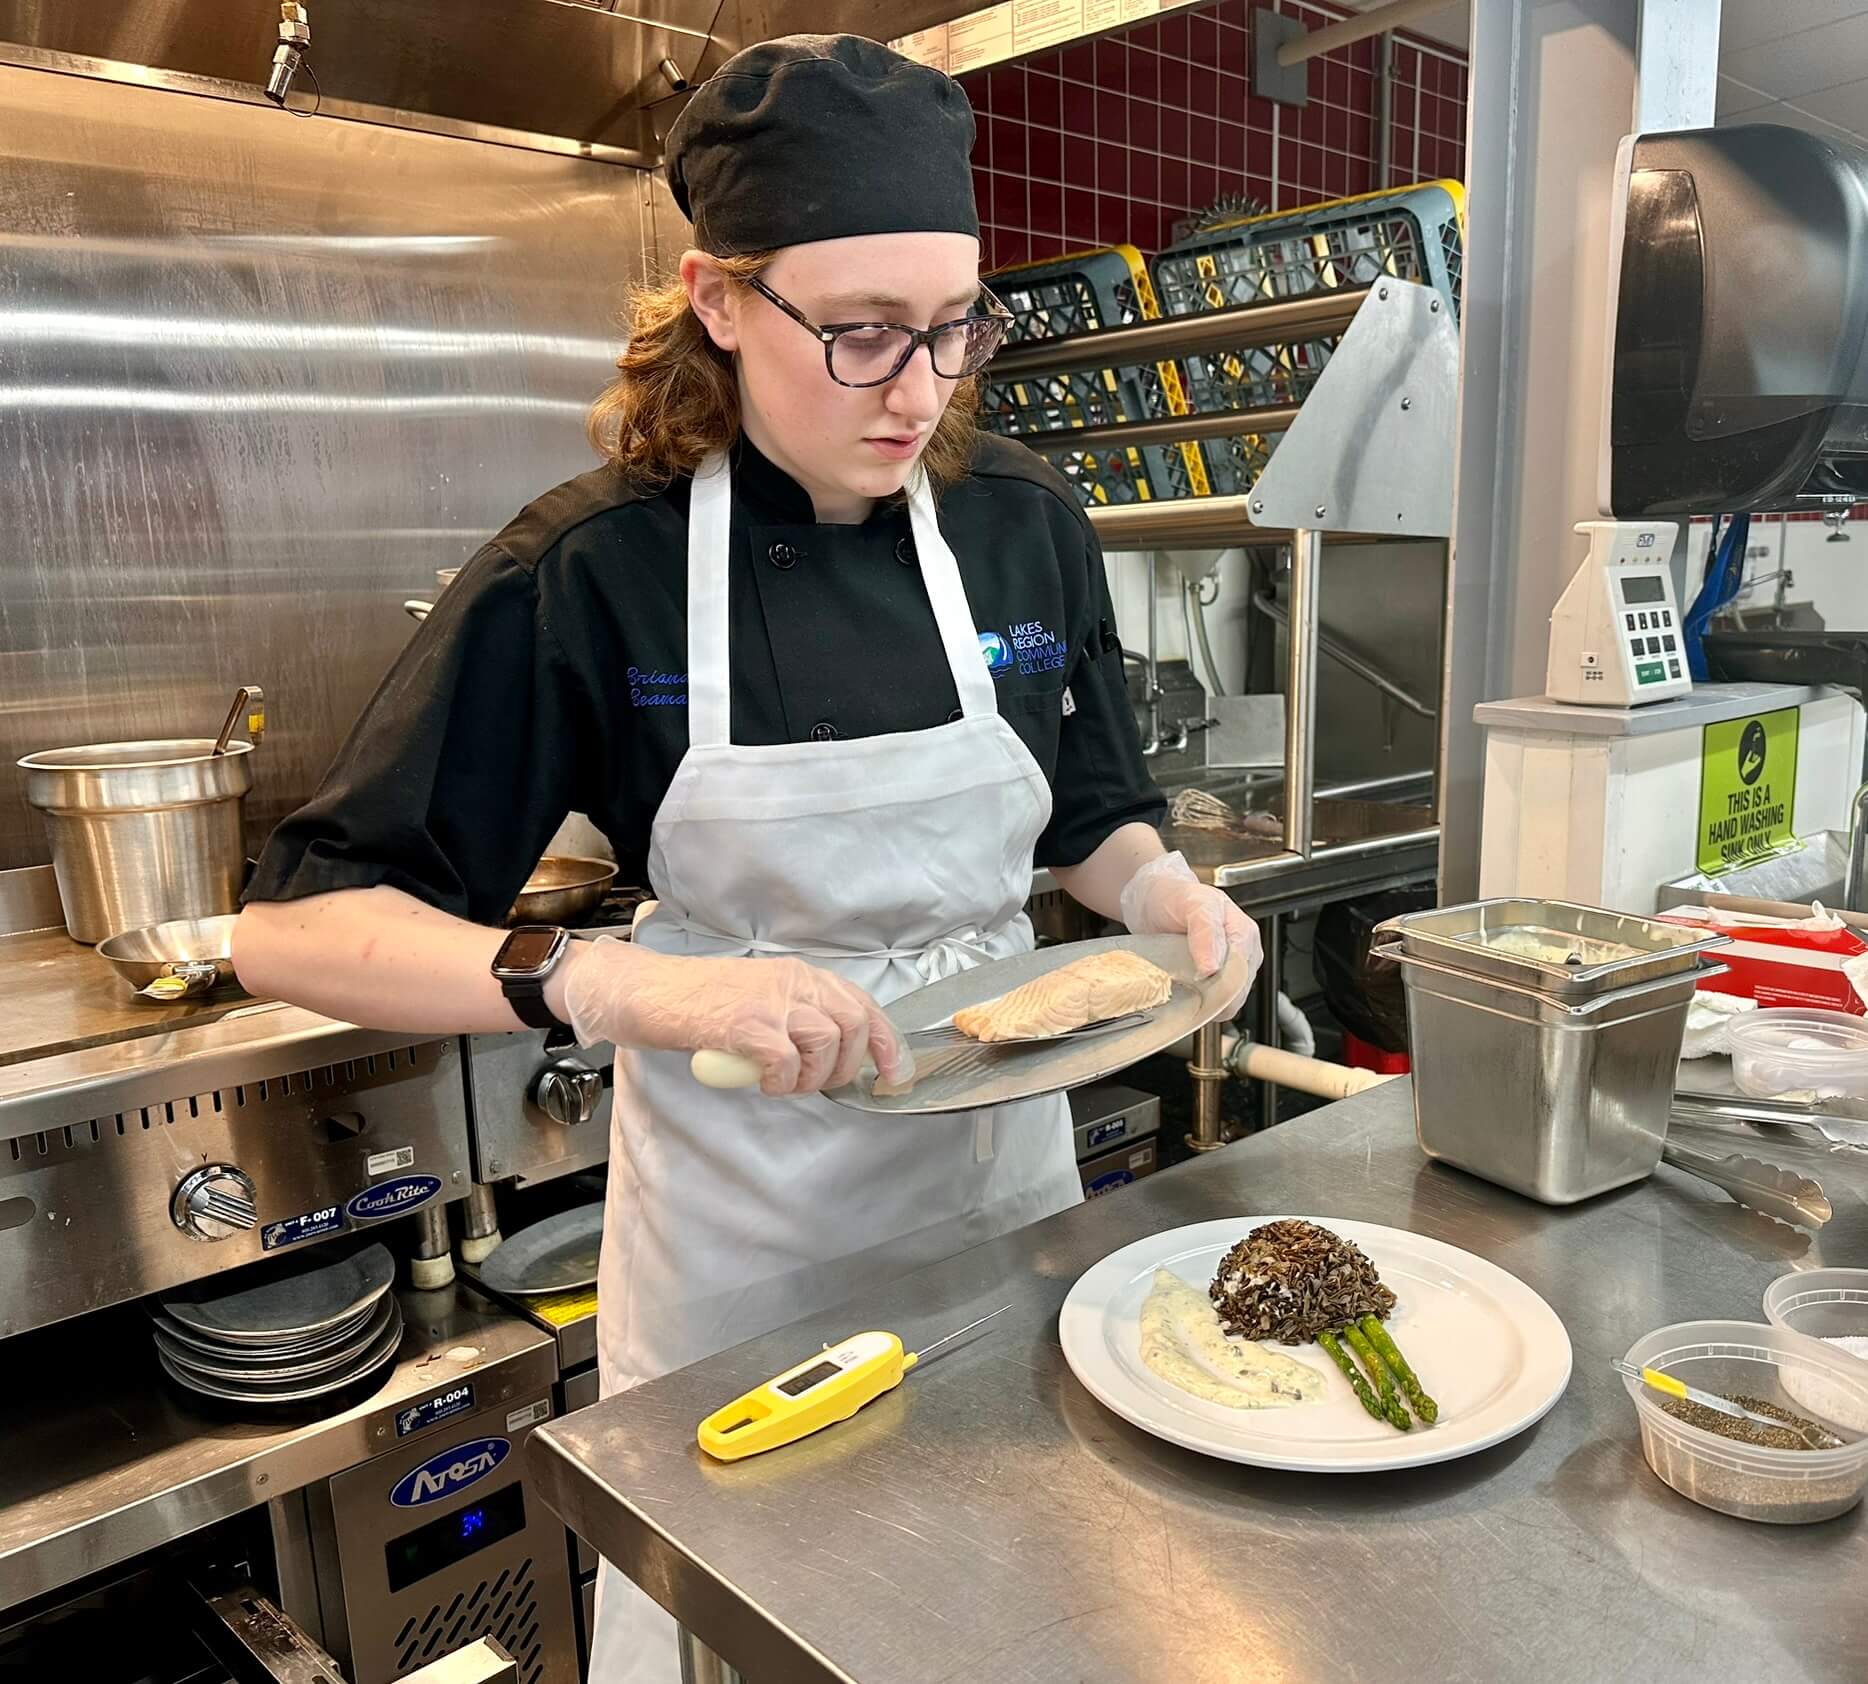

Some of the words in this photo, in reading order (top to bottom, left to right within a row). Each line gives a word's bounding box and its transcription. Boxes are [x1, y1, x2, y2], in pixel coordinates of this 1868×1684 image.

[1008, 621, 1043, 637] LAKES
[1012, 631, 1056, 650] REGION
[1016, 640, 1068, 662] COMMUN
[1019, 655, 1066, 675] COLLEGE
[1727, 788, 1750, 816] THIS
[1751, 785, 1763, 809] IS
[1763, 783, 1771, 805] A
[1708, 817, 1738, 846] HAND
[1739, 803, 1785, 836] WASHING
[1720, 838, 1748, 864] SINK
[1746, 830, 1775, 857] ONLY
[432, 1386, 470, 1409] R-004
[410, 1450, 496, 1503] ATOSA
